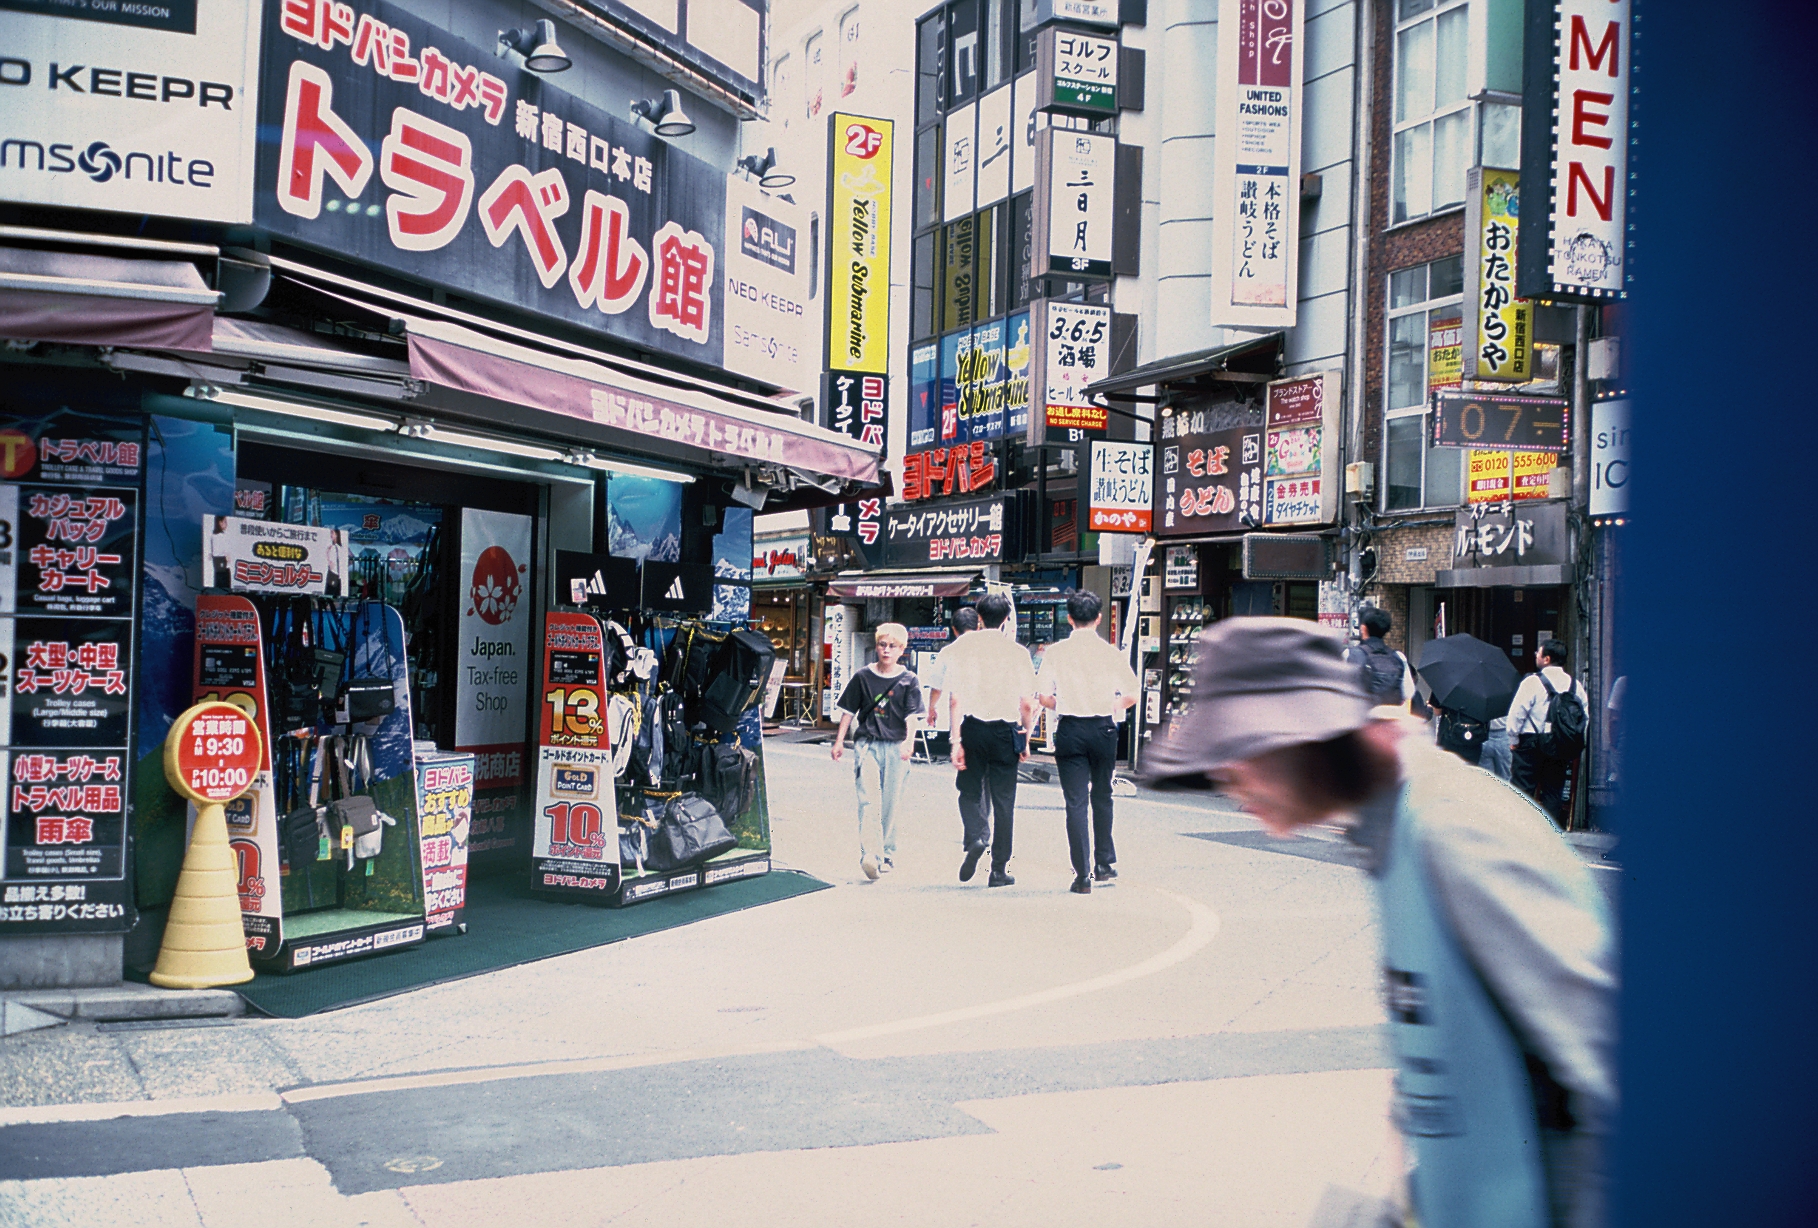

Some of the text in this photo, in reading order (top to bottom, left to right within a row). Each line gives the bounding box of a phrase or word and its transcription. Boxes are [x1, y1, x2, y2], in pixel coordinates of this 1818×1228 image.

[121, 3, 171, 18] MISSION
[1065, 2, 1108, 17] 新宿営業所
[1060, 38, 1111, 61] ゴルフ
[281, 0, 508, 126] ヨドバシカメラ
[1060, 61, 1110, 79] スクール
[48, 63, 234, 111] KEEPR
[1076, 92, 1091, 102] 4F
[1246, 90, 1282, 103] UNITED
[1239, 103, 1288, 117] FASHIONS
[1566, 0, 1620, 222] MEN
[516, 99, 653, 195] 新宿西口本店
[845, 124, 883, 157] 2F
[1256, 166, 1269, 175] 2F
[277, 60, 714, 345] トラベル館
[1066, 170, 1094, 252] 三日月
[1238, 180, 1257, 278] 讃岐うどん
[1262, 181, 1281, 260] 本格そば
[1563, 236, 1614, 251] HAKATA
[1071, 257, 1089, 270] 3F
[1554, 249, 1621, 266] TONKOTSU
[849, 198, 870, 360] Yellow Submarine
[1567, 264, 1608, 280] RAMEN
[728, 278, 804, 318] NEO KEEPR
[1480, 221, 1511, 372] おたからや
[1513, 308, 1527, 374] 新宿西口店
[1058, 343, 1096, 368] 酒場
[1273, 383, 1313, 398] ブランドストアー
[942, 407, 957, 435] 2F
[1081, 420, 1103, 428] CHARGE
[1068, 428, 1084, 441] B1
[40, 437, 140, 467] トラベル館
[1095, 448, 1151, 476] 生そば
[1186, 445, 1230, 477] そば
[1485, 457, 1509, 471] 0120
[1513, 452, 1557, 469] 555-600
[903, 440, 994, 500] ヨドバシ
[1094, 477, 1150, 504] 讃岐うどん
[1180, 485, 1235, 517] うどん
[1277, 480, 1321, 499] 金券売買
[29, 494, 125, 520] カジュアル
[1094, 511, 1137, 528] かのや
[1276, 500, 1319, 519] ダイヤチケット
[1470, 500, 1512, 520] ステーキ
[46, 518, 107, 542] バッグ
[240, 523, 318, 543] 普段使いからご旅行まで
[363, 514, 380, 531] 傘
[888, 503, 1003, 539] ケータイアクセサリー館
[929, 533, 1001, 561] ヨドバシカメラ
[1456, 520, 1534, 556] ル・モンド
[29, 544, 122, 570] キャリー
[256, 543, 303, 560] あると便利な
[39, 569, 111, 594] カート
[234, 559, 323, 588] ミニショルダー
[34, 594, 56, 602] Casual
[102, 596, 116, 604] cart
[27, 641, 119, 669] 大型・中型
[471, 636, 516, 661] Japan.
[16, 669, 127, 695] スーツケース
[467, 665, 519, 686] Tax-free
[32, 707, 108, 718] (Large/Middle size)
[45, 698, 97, 708] Trolley cases
[475, 691, 508, 714] Shop
[546, 687, 605, 735] 13%
[192, 720, 246, 736] 営業時間
[550, 732, 599, 748] ポイント還元
[206, 737, 244, 756] 9:30
[14, 754, 121, 783] 小型スーツケース
[200, 768, 247, 787] 10:00
[424, 764, 473, 790] ヨドバシ
[474, 751, 521, 780] 税商店
[564, 771, 588, 782] GOLD
[557, 781, 593, 791] POINT CARD
[12, 785, 122, 813] トラベル用品
[422, 788, 470, 814] おすすめ
[36, 816, 94, 845] 雨傘
[543, 801, 606, 848] 10%
[422, 837, 452, 868] 満載
[549, 843, 603, 860] ポイント還元
[544, 872, 607, 890] ヨドバシカメラ
